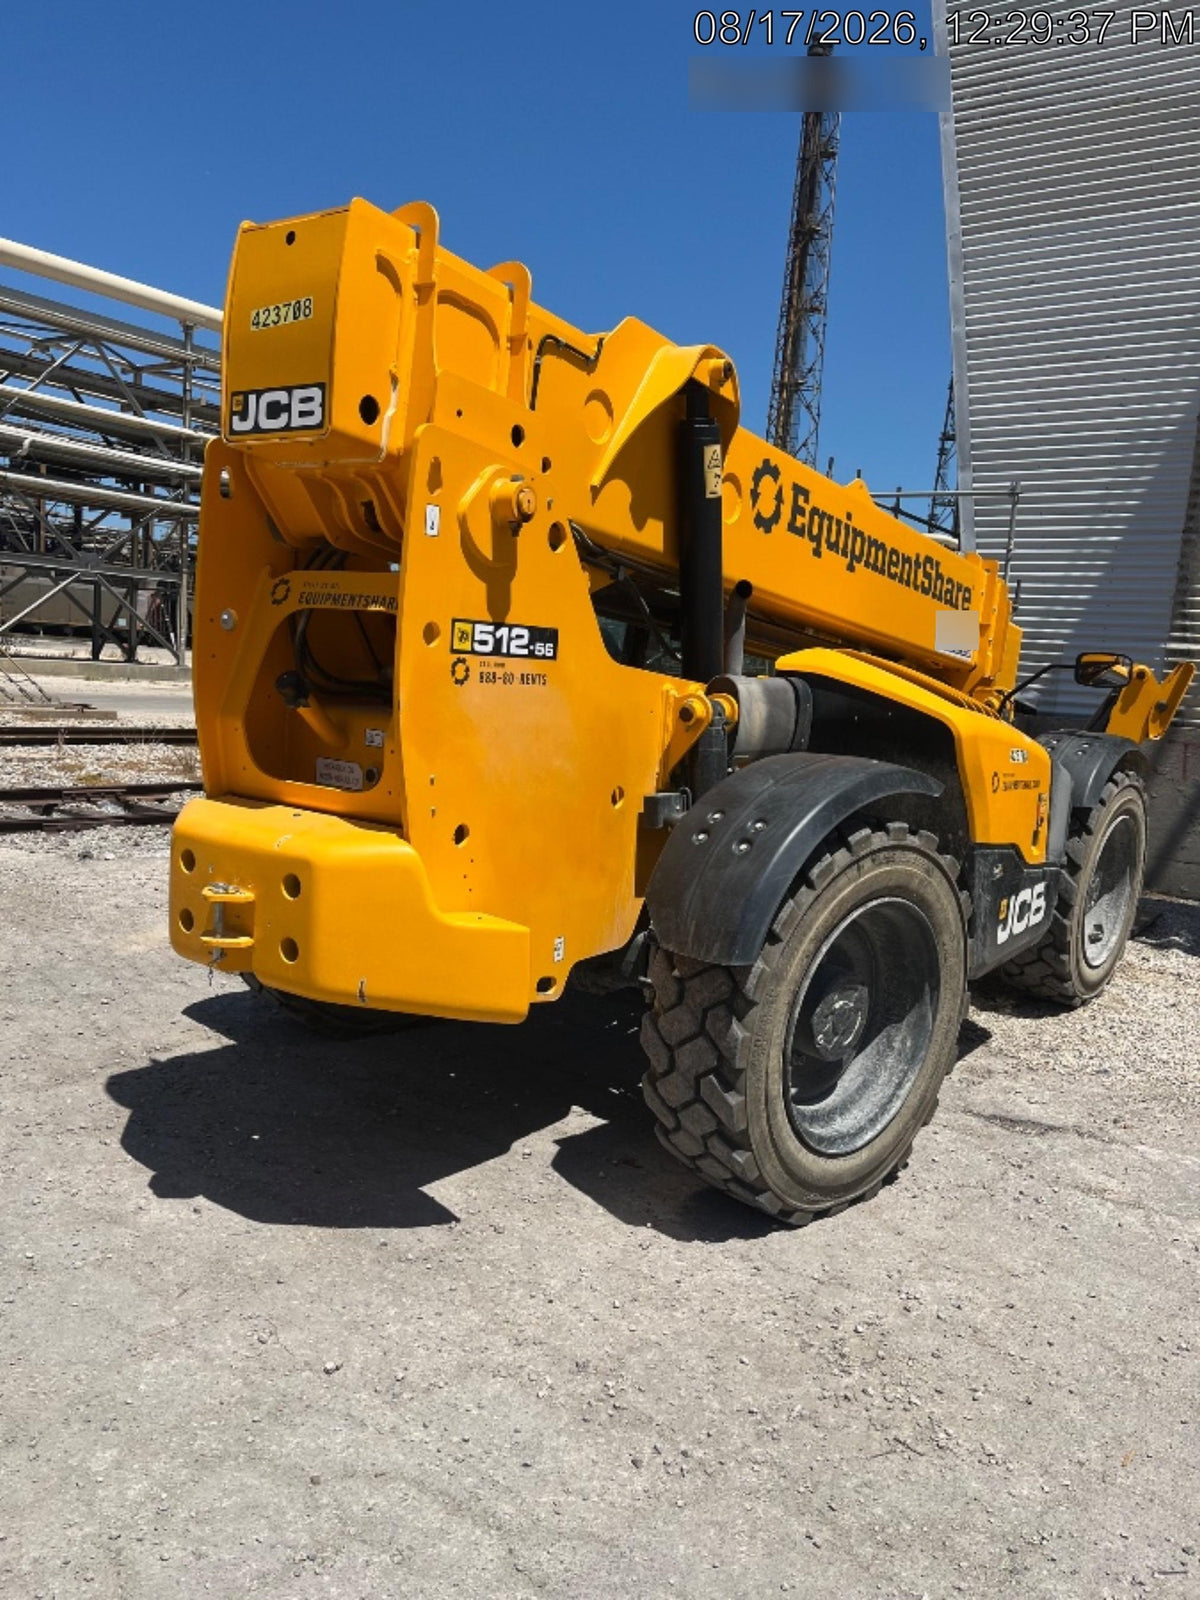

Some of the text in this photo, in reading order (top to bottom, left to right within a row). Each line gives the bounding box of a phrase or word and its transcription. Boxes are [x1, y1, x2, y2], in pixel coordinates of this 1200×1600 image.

[251, 298, 312, 330] 423708
[231, 387, 323, 431] JCB
[787, 482, 972, 611] EquipmentShare
[997, 881, 1048, 945] JCB
